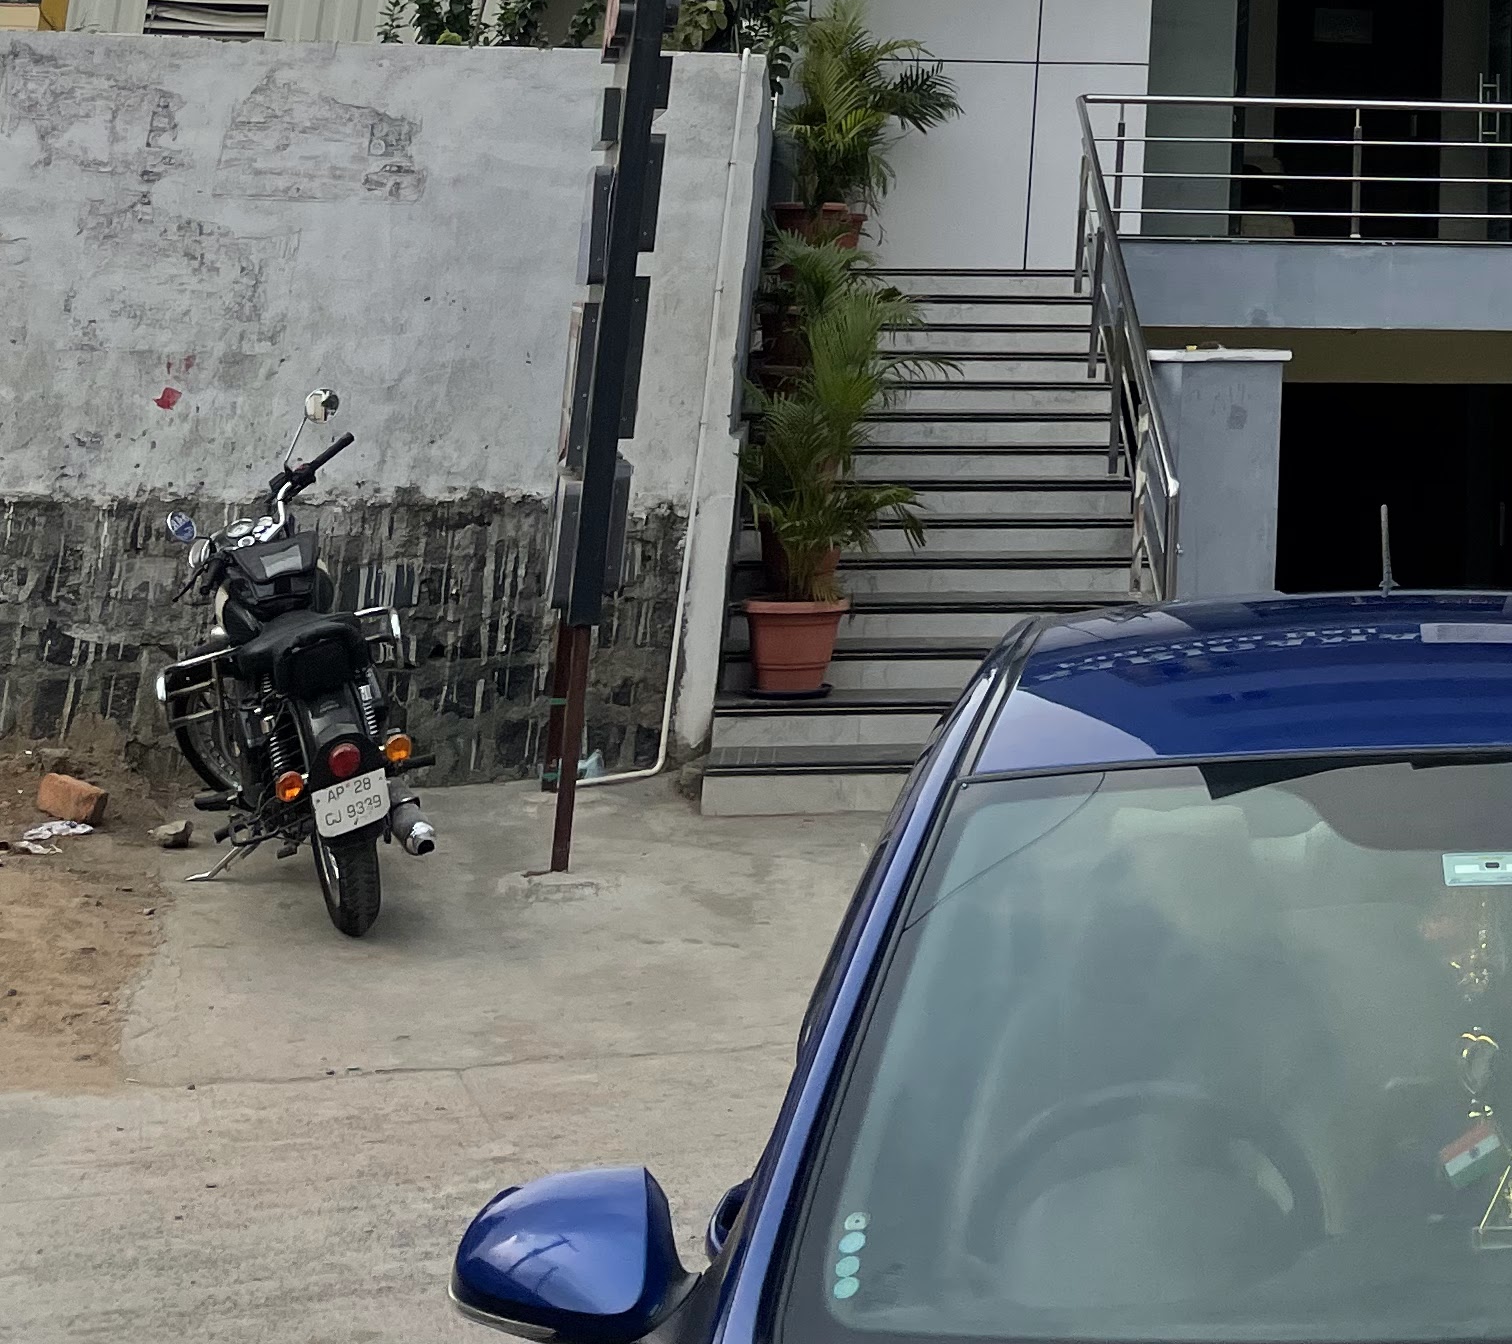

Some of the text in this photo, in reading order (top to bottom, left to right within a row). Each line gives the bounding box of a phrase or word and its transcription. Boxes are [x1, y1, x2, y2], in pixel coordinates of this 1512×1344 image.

[327, 777, 372, 804] AP 28
[325, 809, 342, 827] CJ
